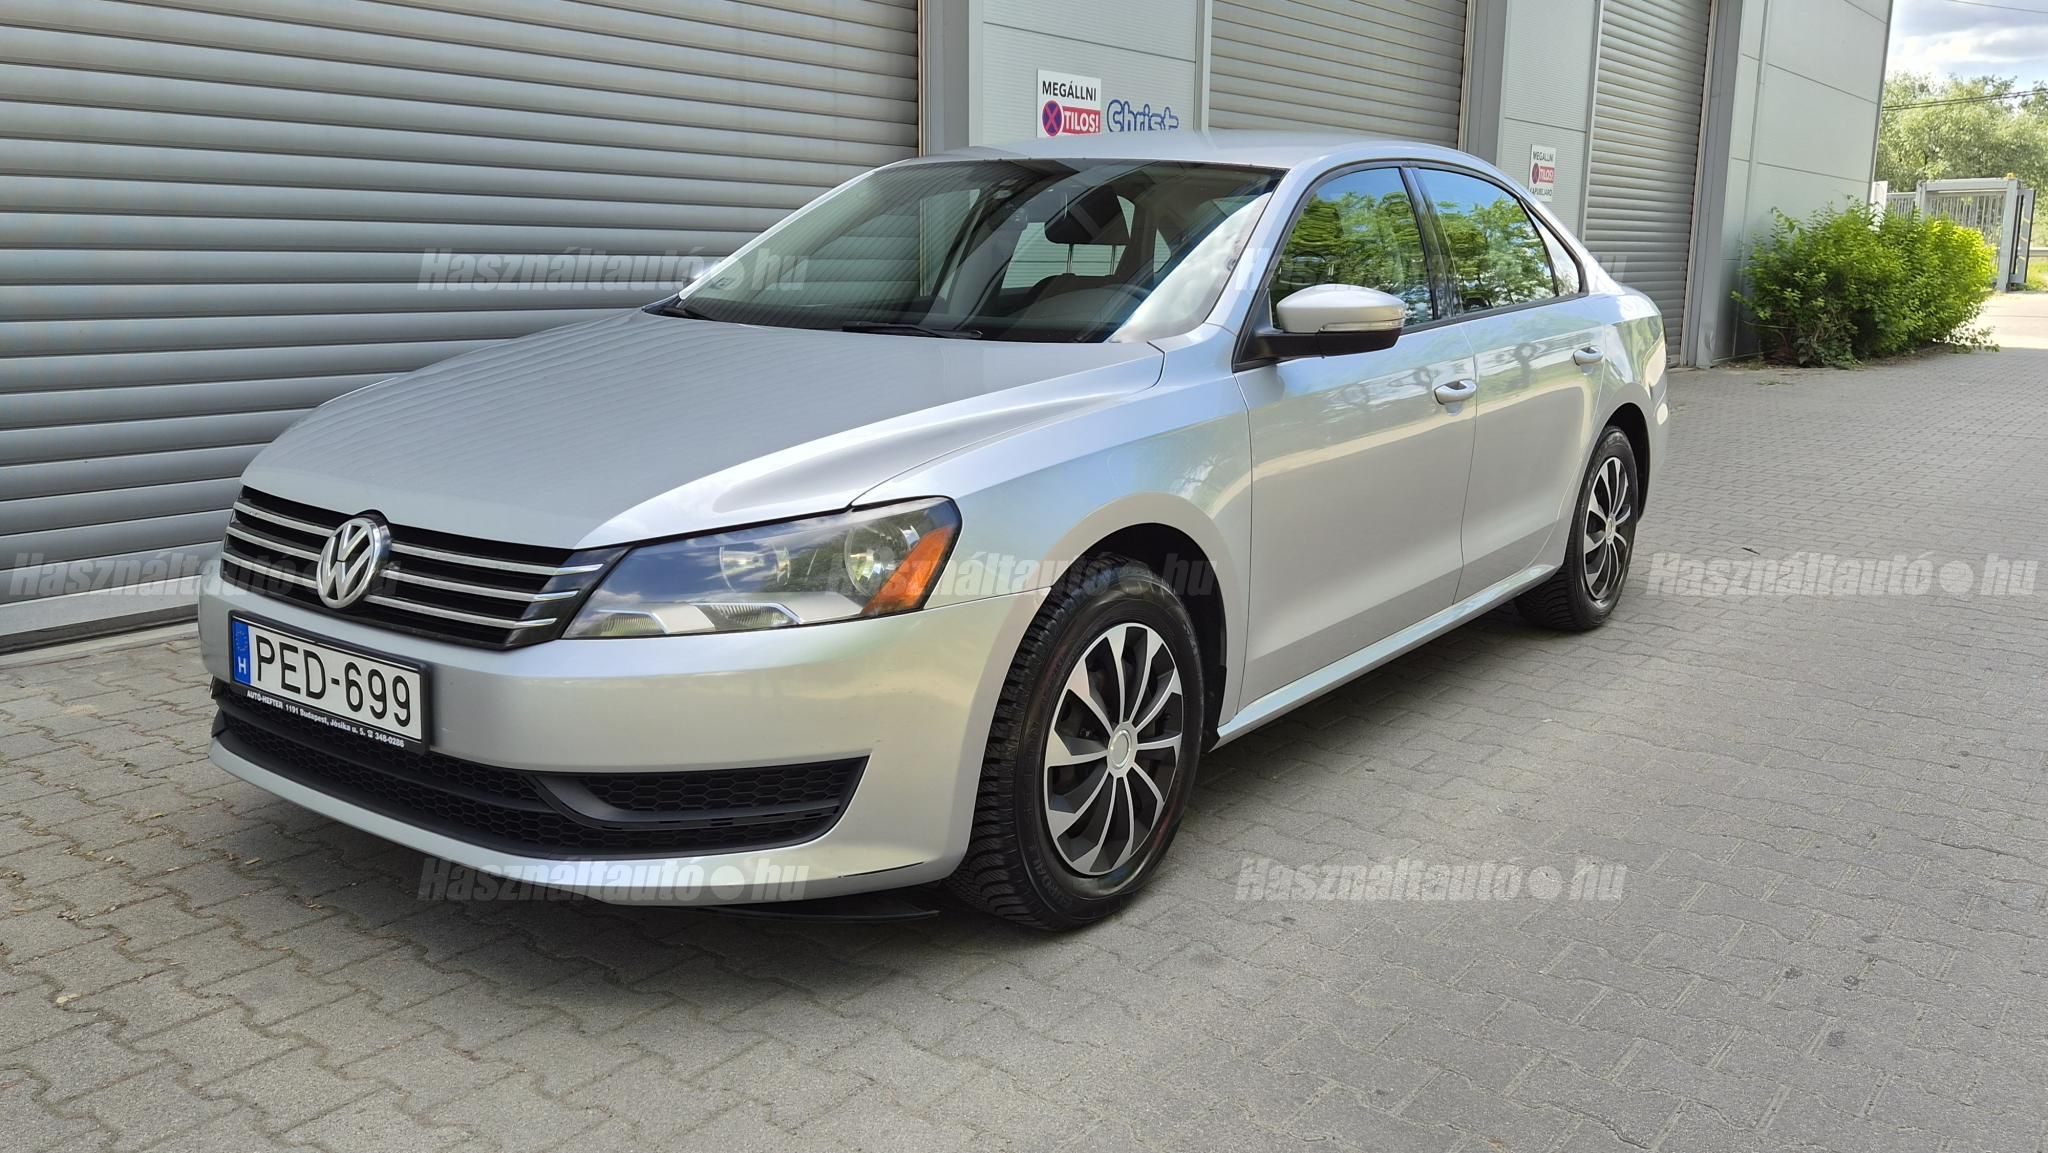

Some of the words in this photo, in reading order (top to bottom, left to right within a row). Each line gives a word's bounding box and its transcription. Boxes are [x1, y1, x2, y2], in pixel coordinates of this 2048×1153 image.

[1042, 80, 1097, 101] MEGÁLLNI
[1064, 110, 1099, 132] TILOS!
[1107, 99, 1179, 132] Christ
[237, 656, 247, 675] H
[255, 634, 411, 727] PED-699
[285, 704, 299, 716] 1191
[299, 708, 329, 726] Budapest,
